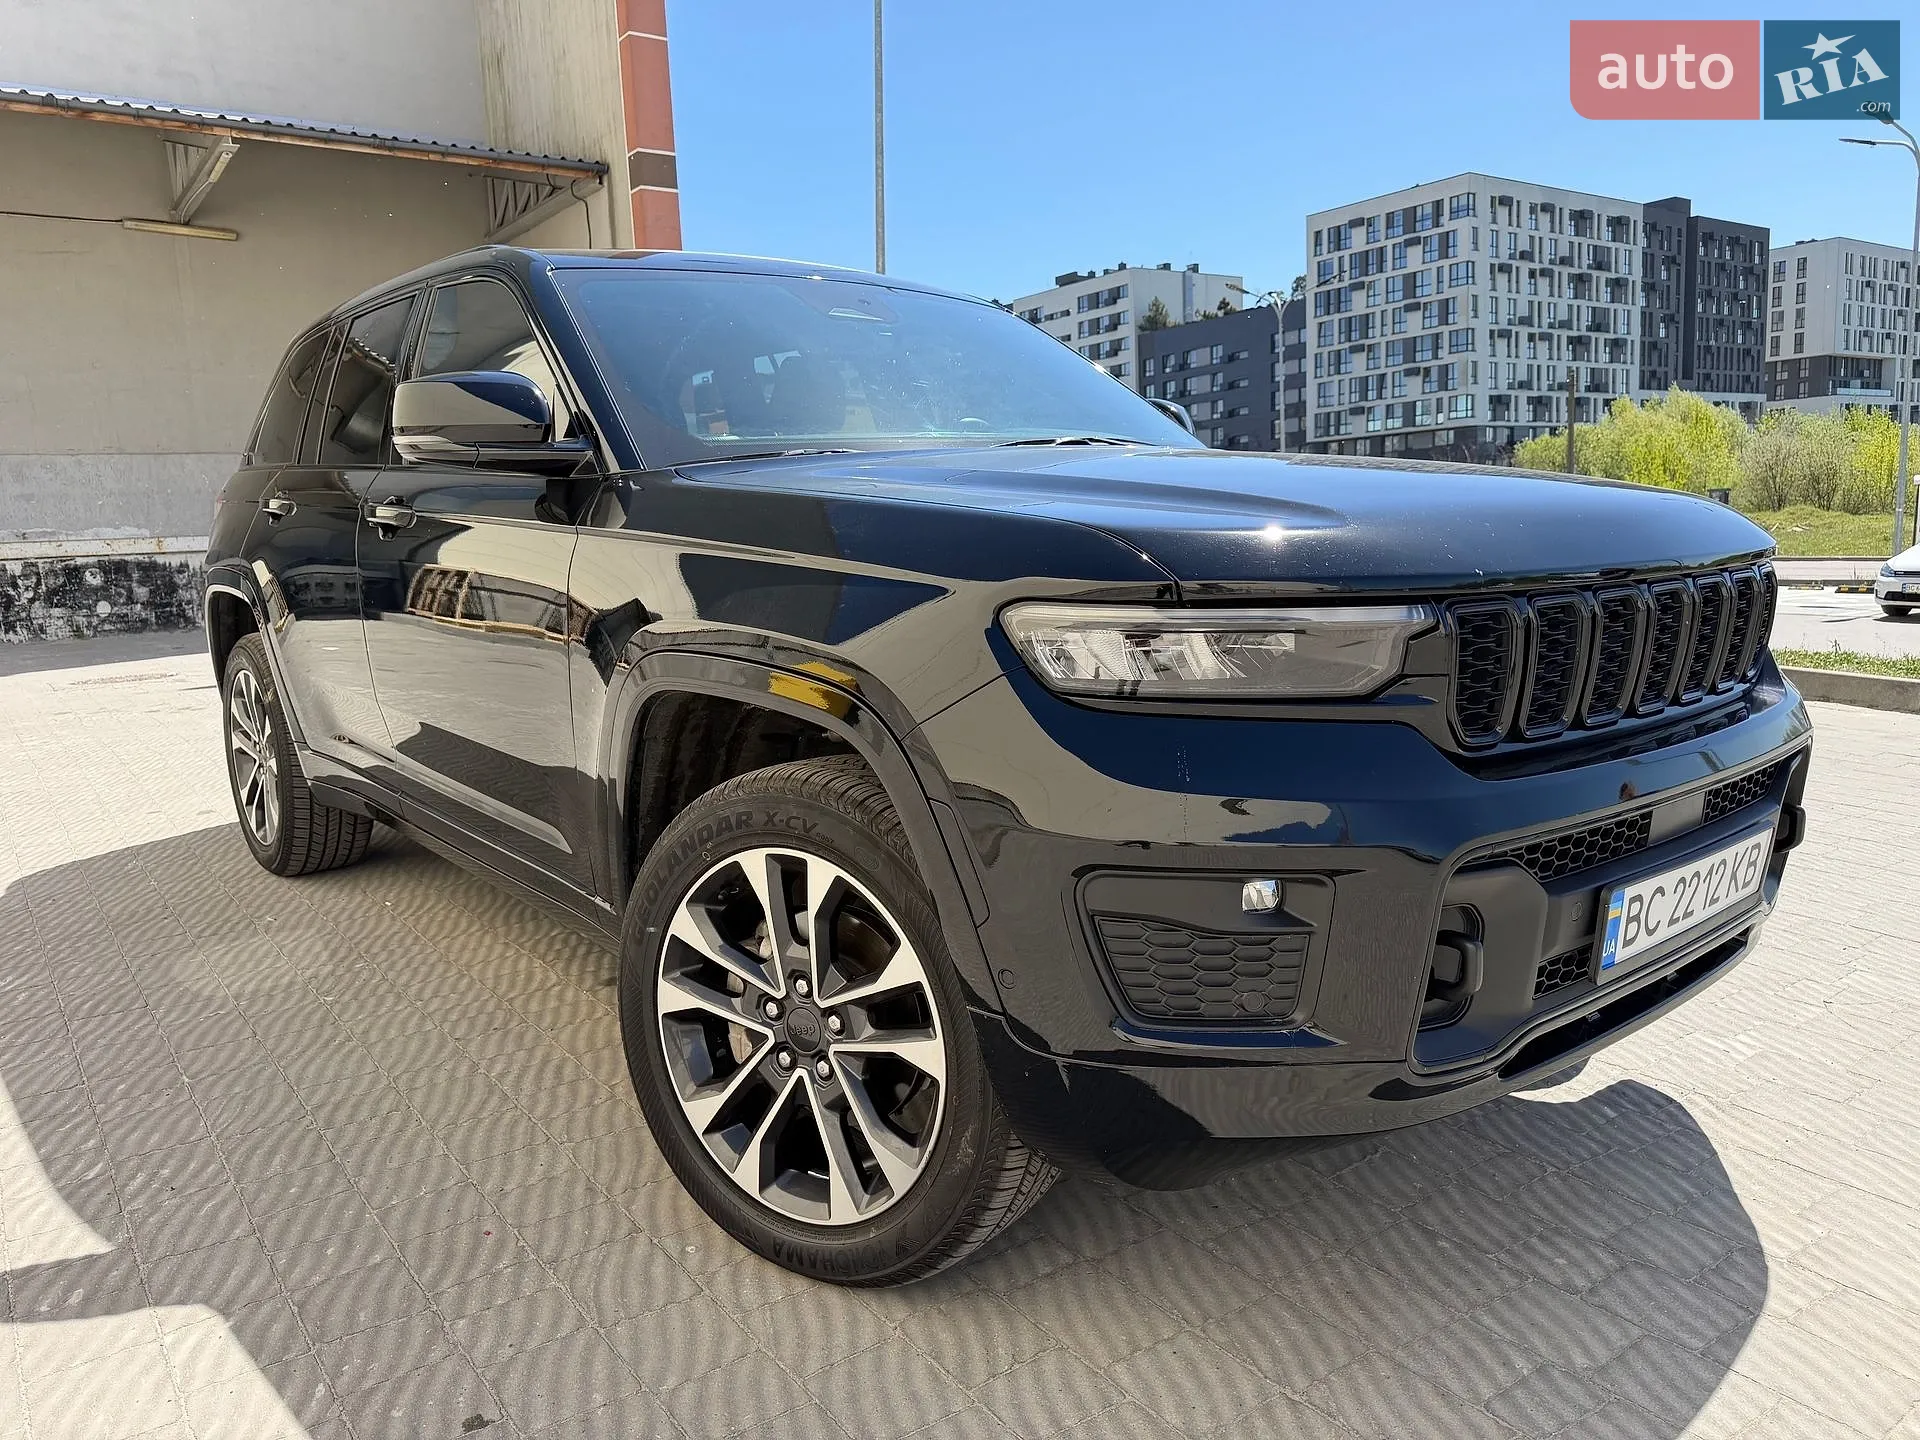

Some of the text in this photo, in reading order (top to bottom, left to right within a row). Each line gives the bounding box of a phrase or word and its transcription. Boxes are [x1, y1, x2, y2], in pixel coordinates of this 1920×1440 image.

[763, 811, 819, 835] X-CV
[1621, 842, 1762, 950] BC 2212 KB
[1602, 939, 1616, 957] UA
[790, 1024, 816, 1037] Jeep
